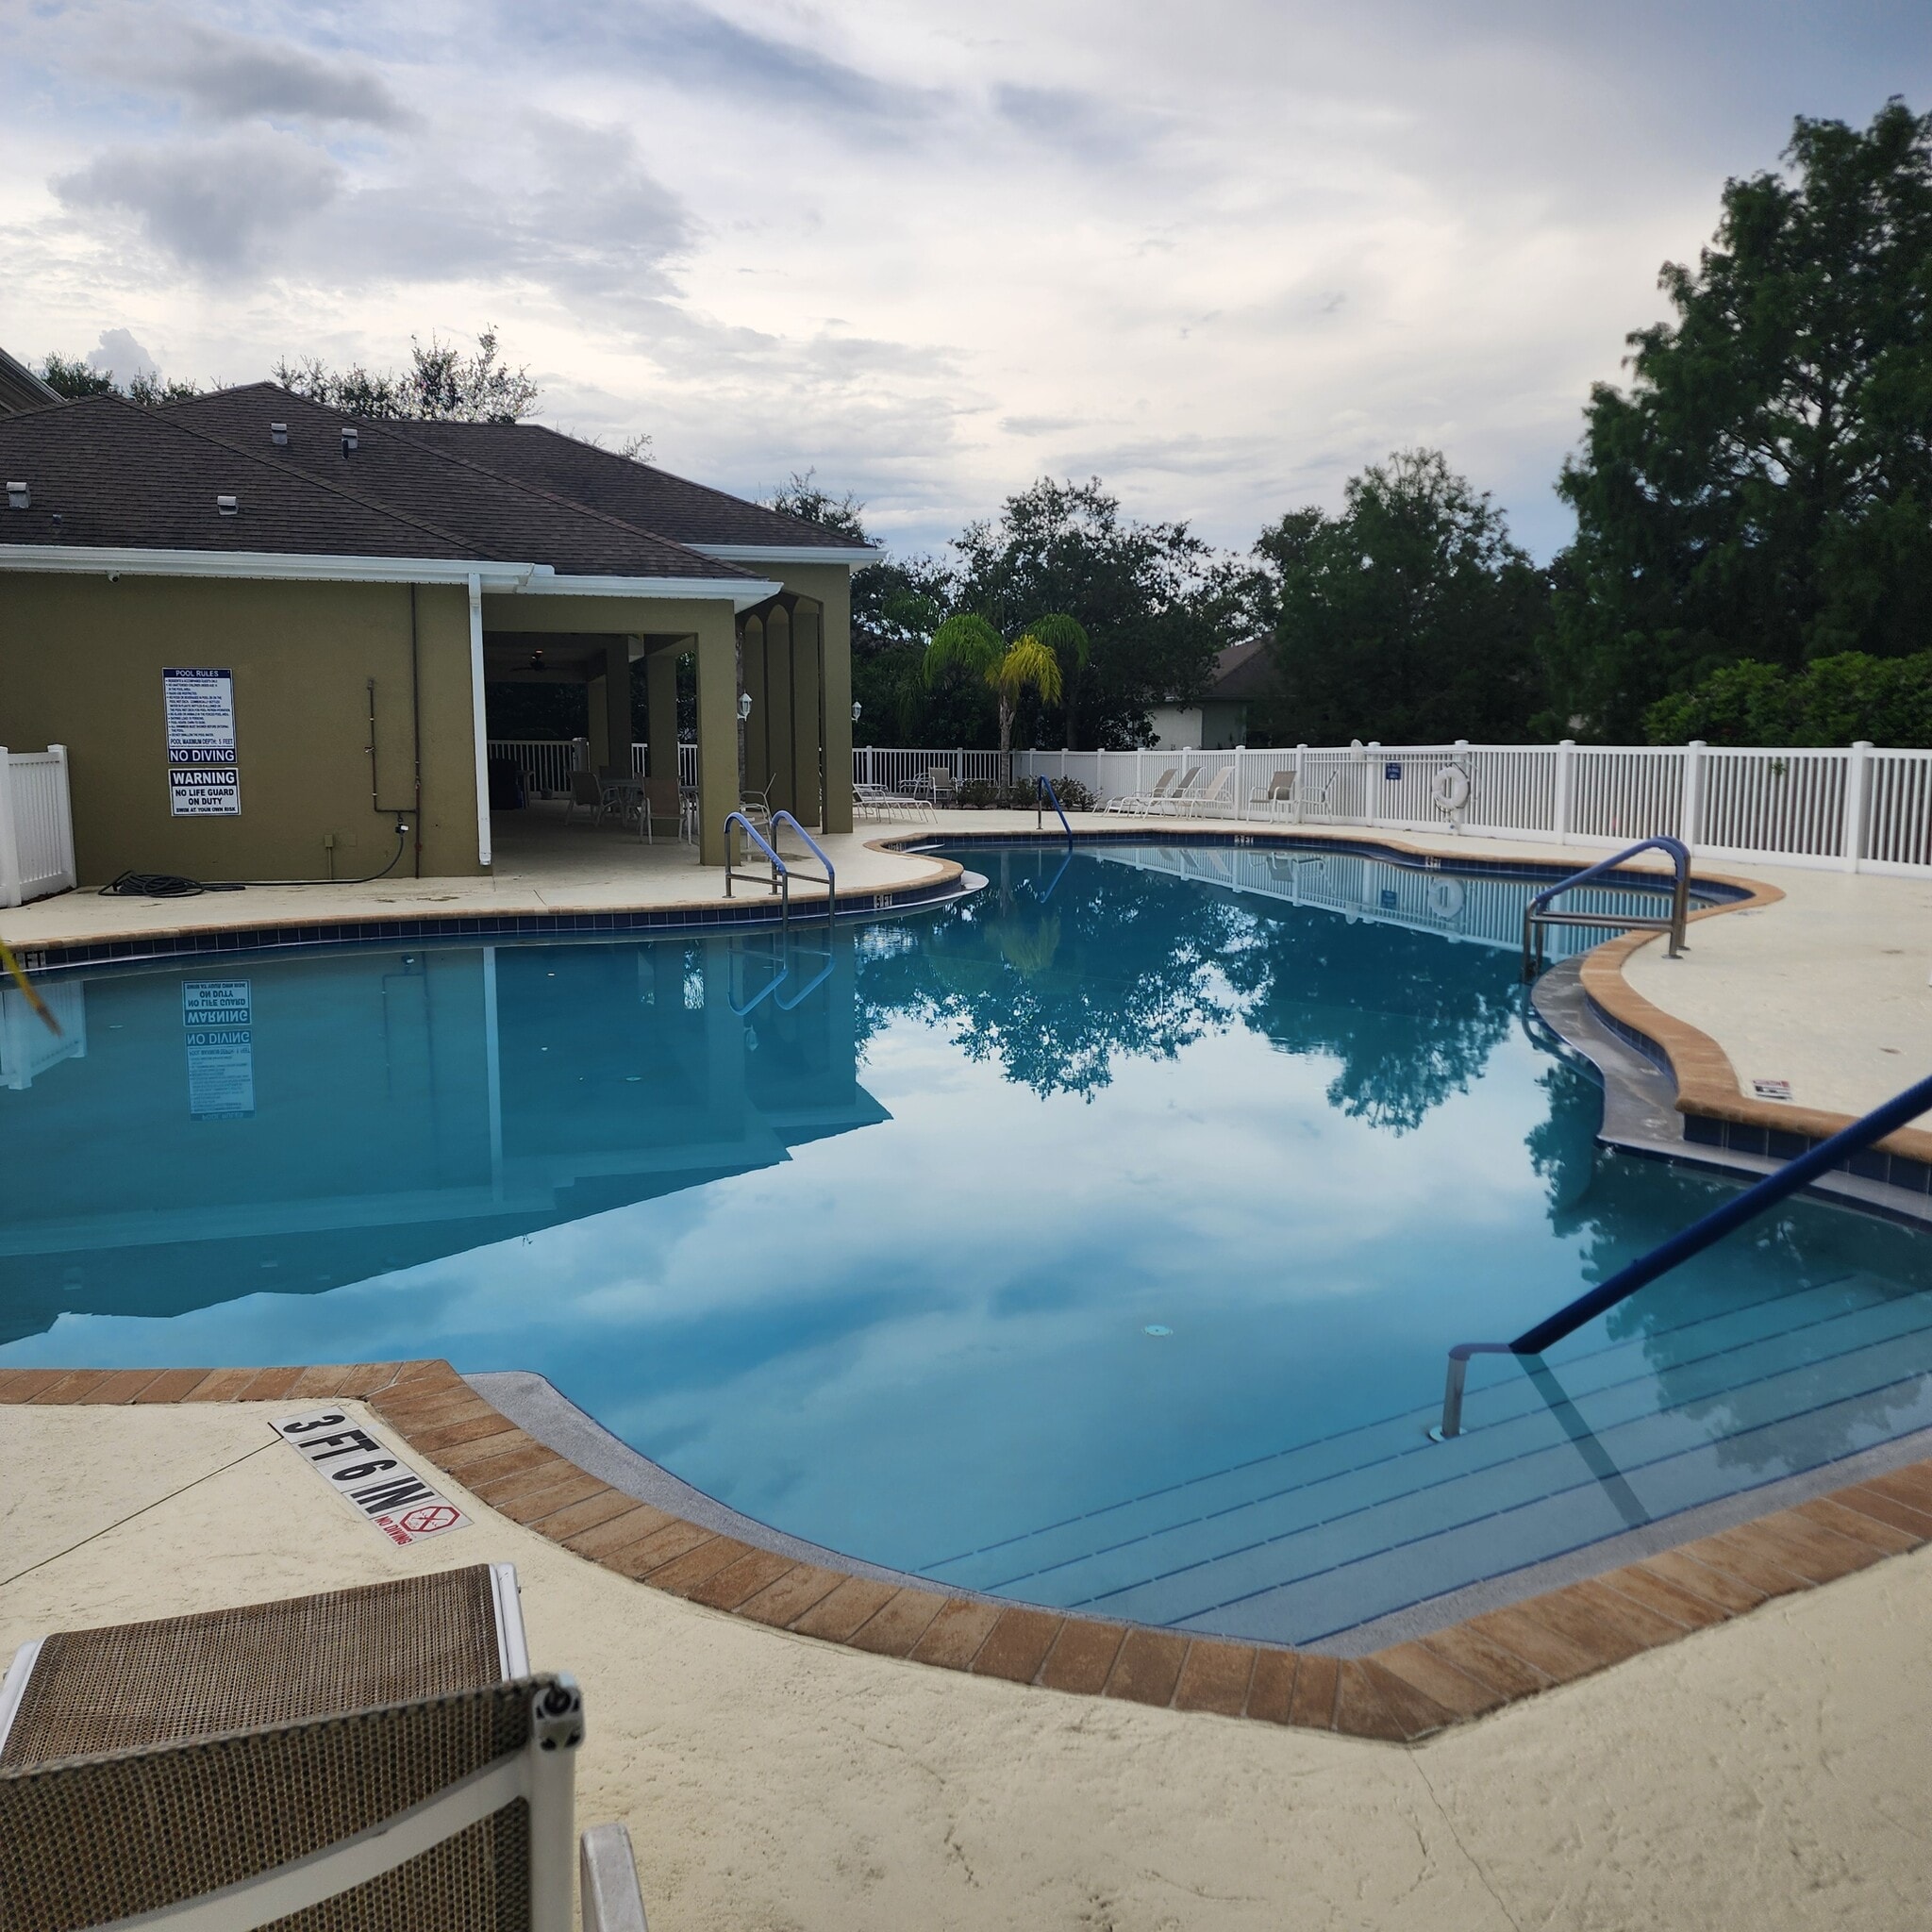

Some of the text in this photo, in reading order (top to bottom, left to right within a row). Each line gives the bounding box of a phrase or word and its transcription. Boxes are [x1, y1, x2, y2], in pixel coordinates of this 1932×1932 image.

[170, 749, 235, 761] NO DIVING
[173, 772, 235, 785] WARNING
[175, 789, 187, 797] NO
[208, 788, 234, 796] GUARD
[883, 893, 892, 907] FT
[25, 949, 44, 969] FT
[283, 1415, 435, 1515] 3 FT 6 IN
[375, 1516, 412, 1545] NO DIVING
